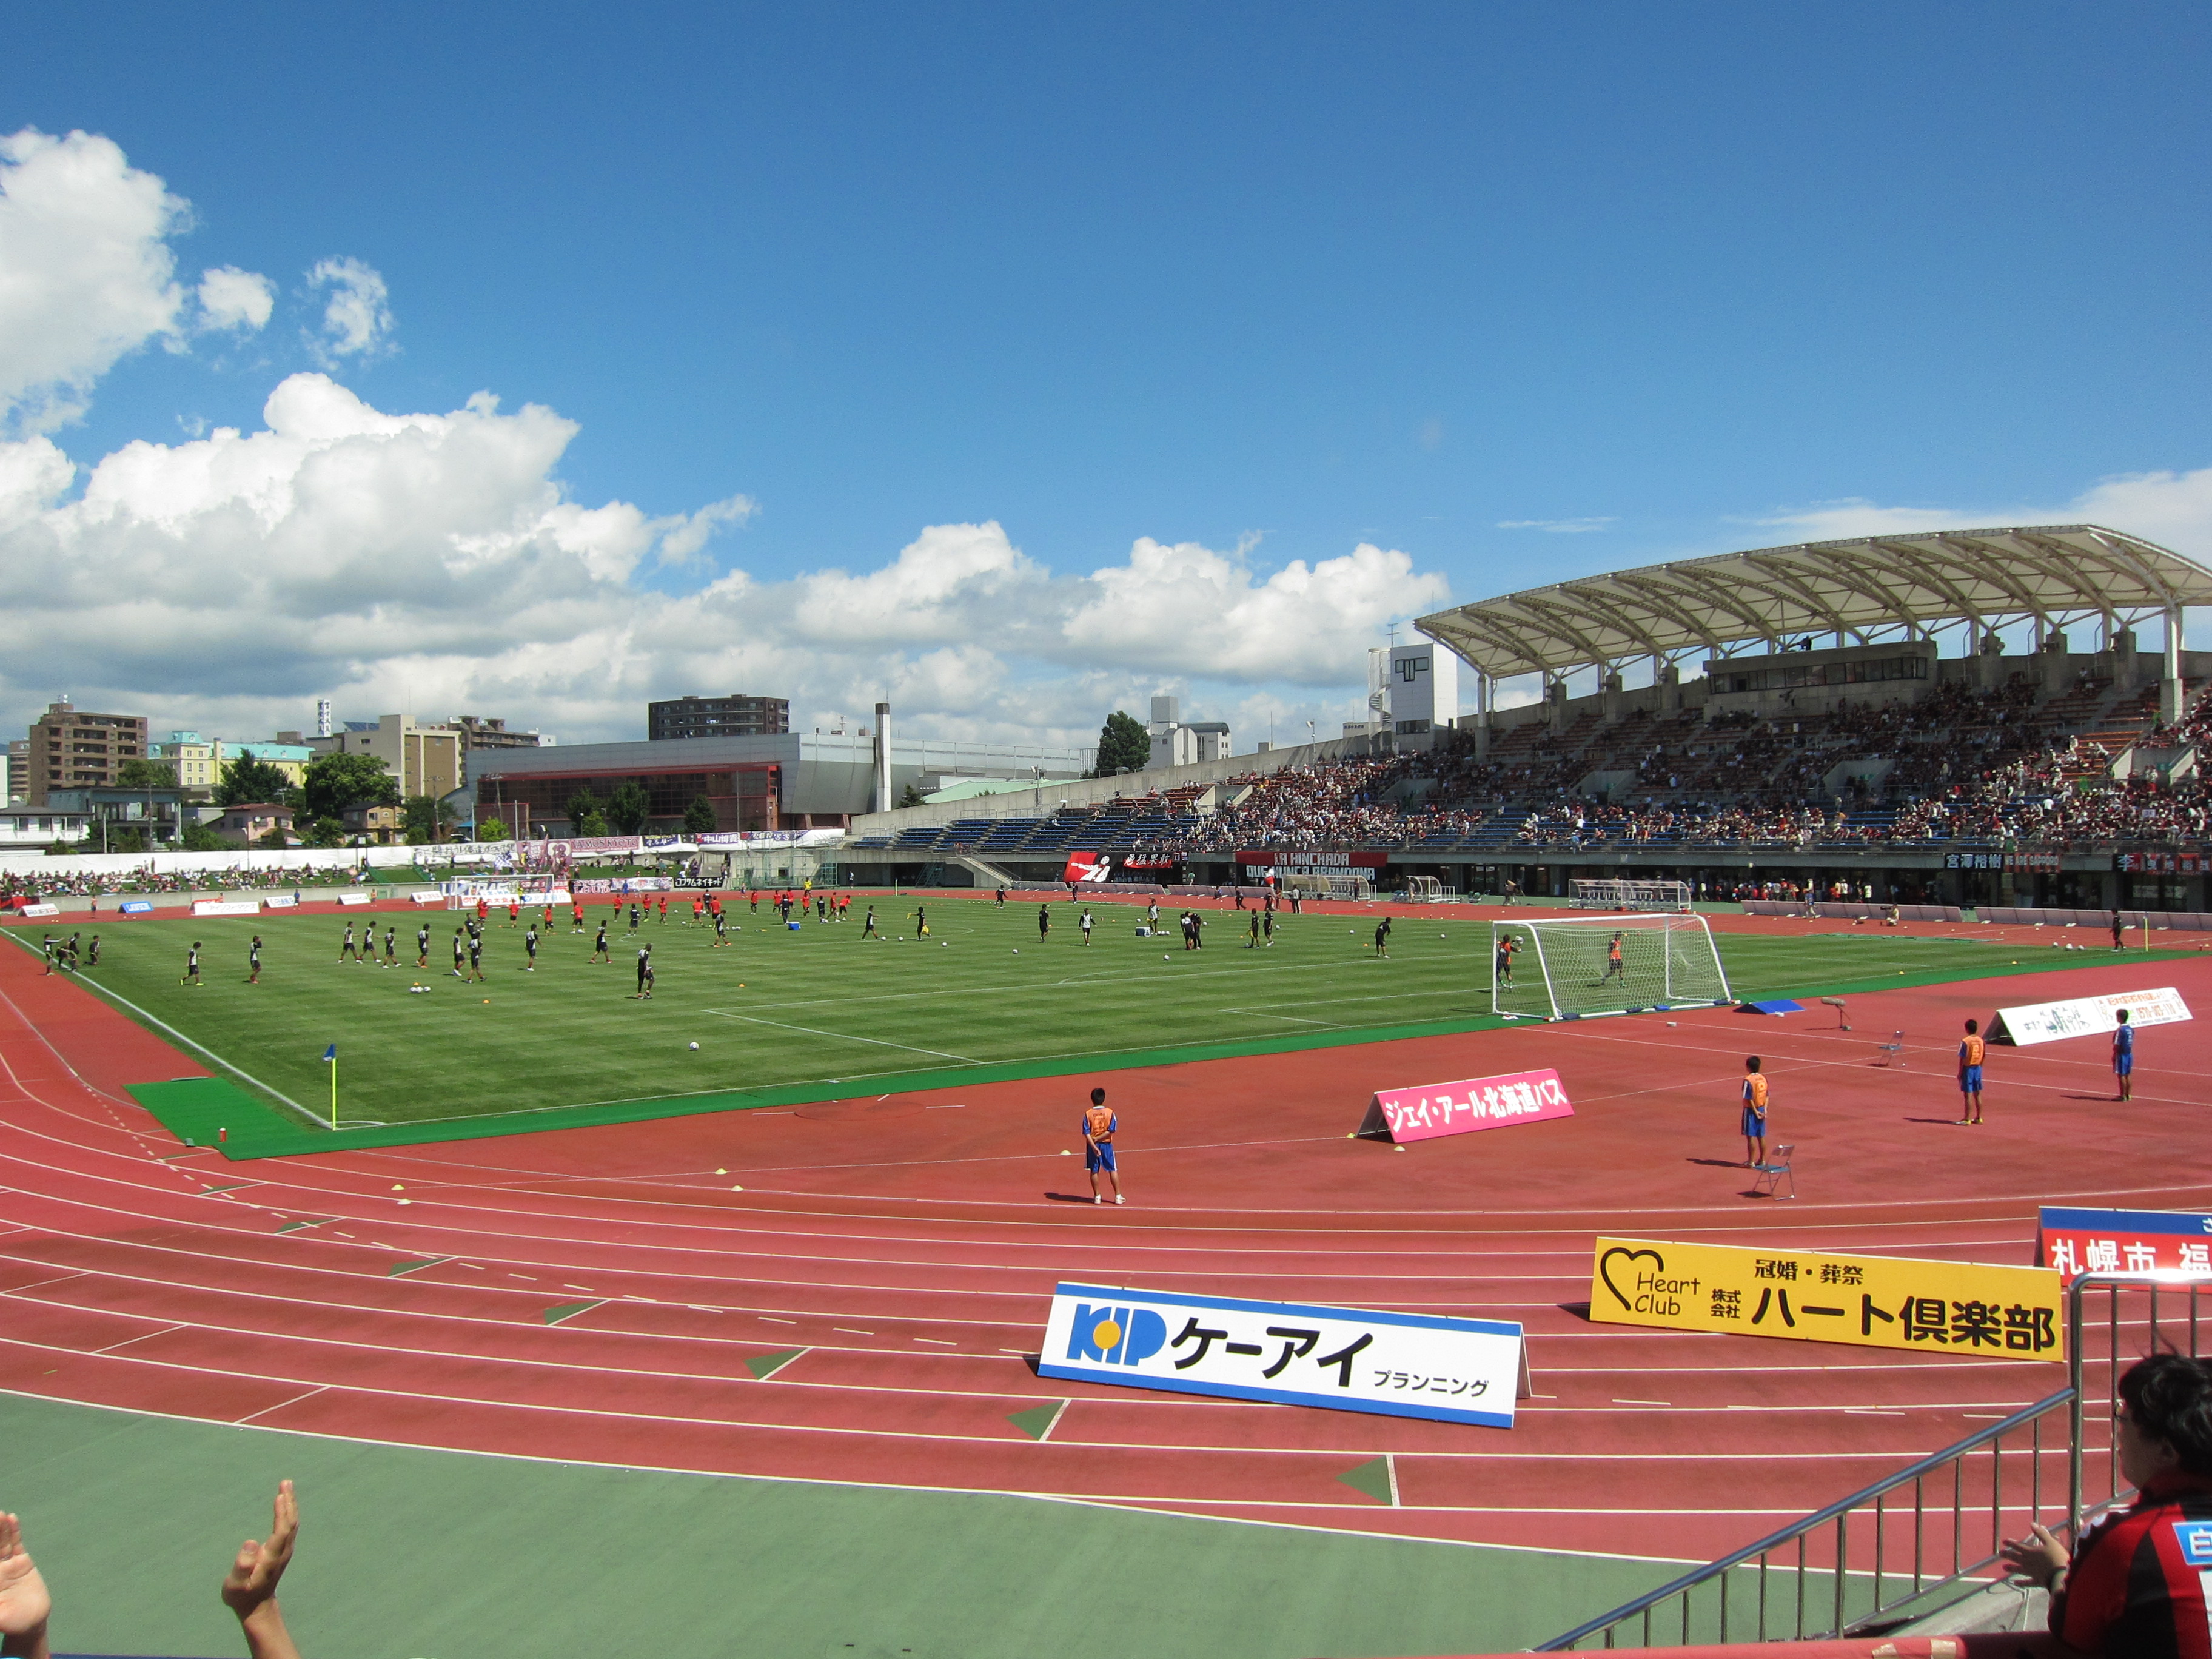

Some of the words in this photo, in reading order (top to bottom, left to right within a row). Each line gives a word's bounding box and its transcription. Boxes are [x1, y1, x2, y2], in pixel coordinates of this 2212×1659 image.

[607, 837, 638, 847] KYOTO
[703, 834, 737, 843] 中山博貴
[1275, 852, 1287, 865] LA
[1385, 1079, 1567, 1133] ジェイ・アール北海道バス
[1636, 1270, 1701, 1296] Heart
[1754, 1258, 1865, 1286] 冠婚・葬祭
[1635, 1294, 1681, 1316] Club
[1711, 1287, 1741, 1304] 株式
[1711, 1303, 1740, 1319] 会社
[1751, 1287, 2056, 1353] ハート倶楽部
[1171, 1316, 1374, 1388] ケーアイ
[1373, 1370, 1490, 1398] プランニング
